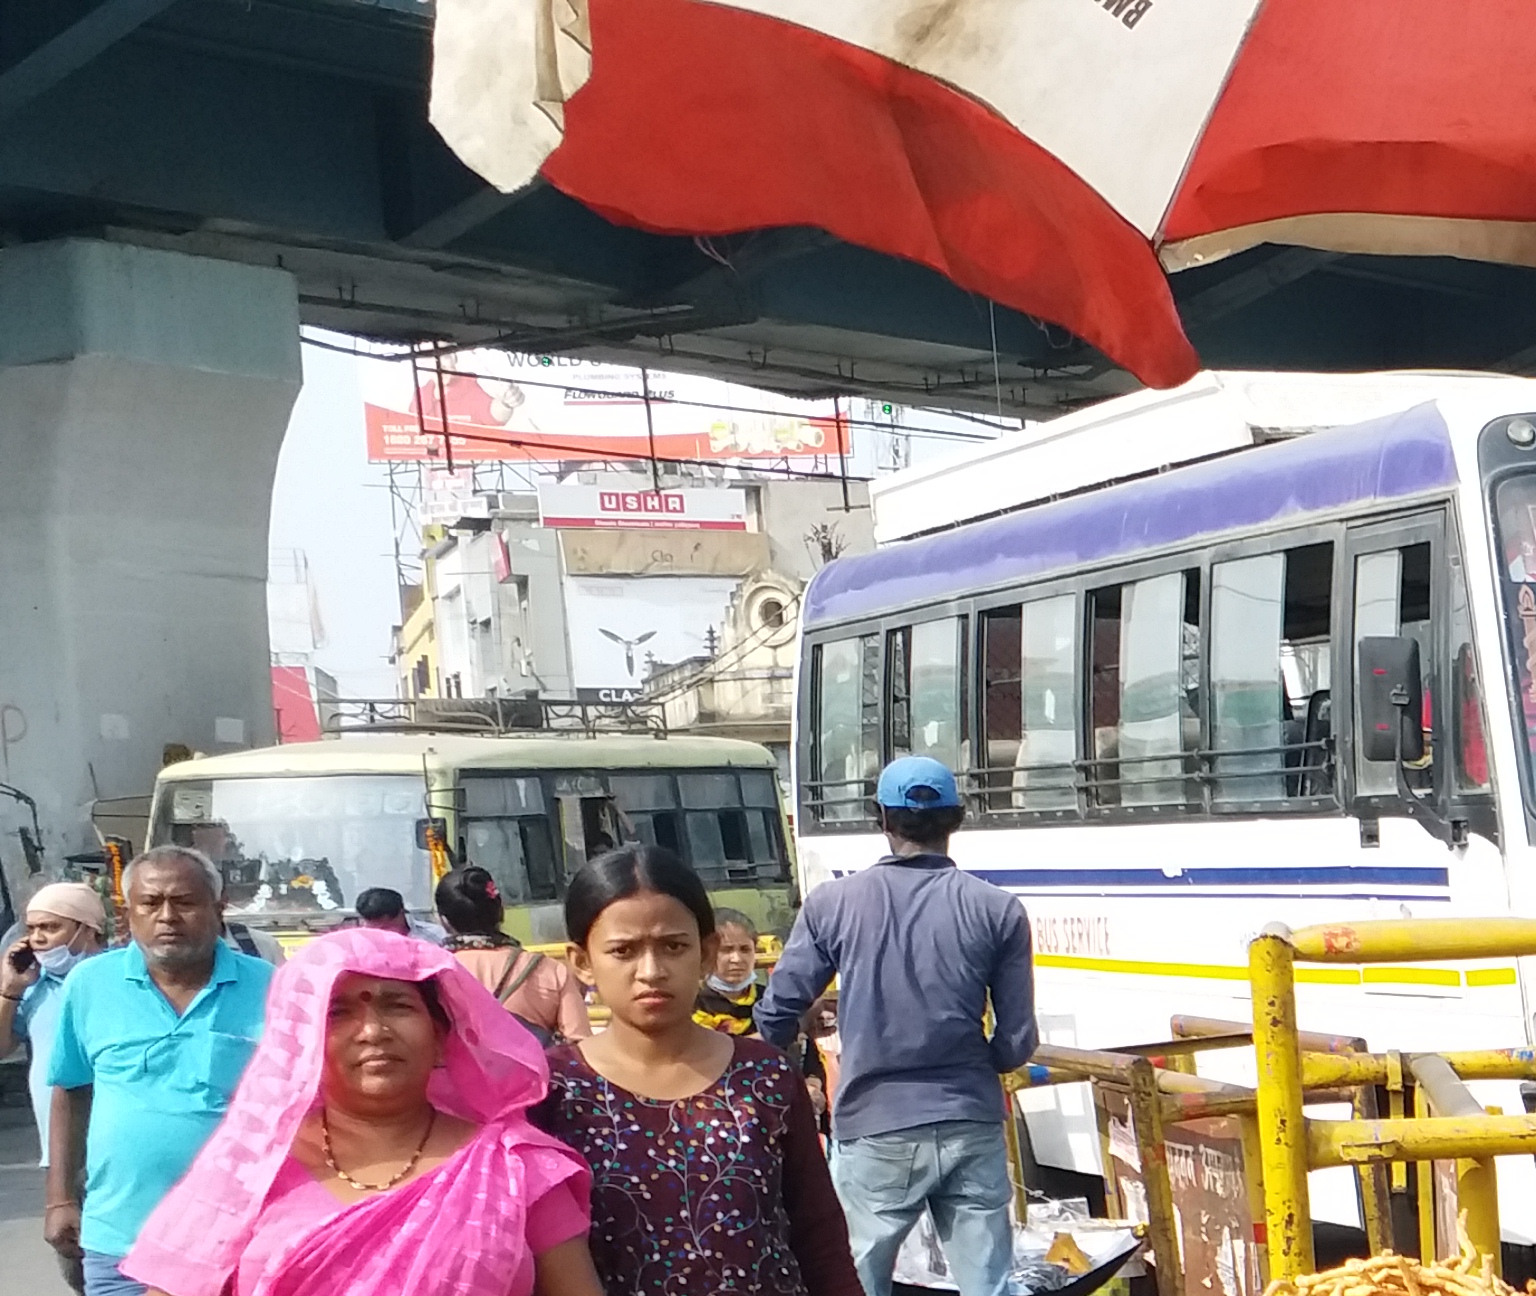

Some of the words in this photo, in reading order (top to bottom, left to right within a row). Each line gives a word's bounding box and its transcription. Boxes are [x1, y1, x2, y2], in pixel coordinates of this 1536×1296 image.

[602, 493, 683, 513] USHA
[598, 689, 638, 702] CLA
[1036, 917, 1059, 953] BUS
[1062, 917, 1111, 956] SERVICE
